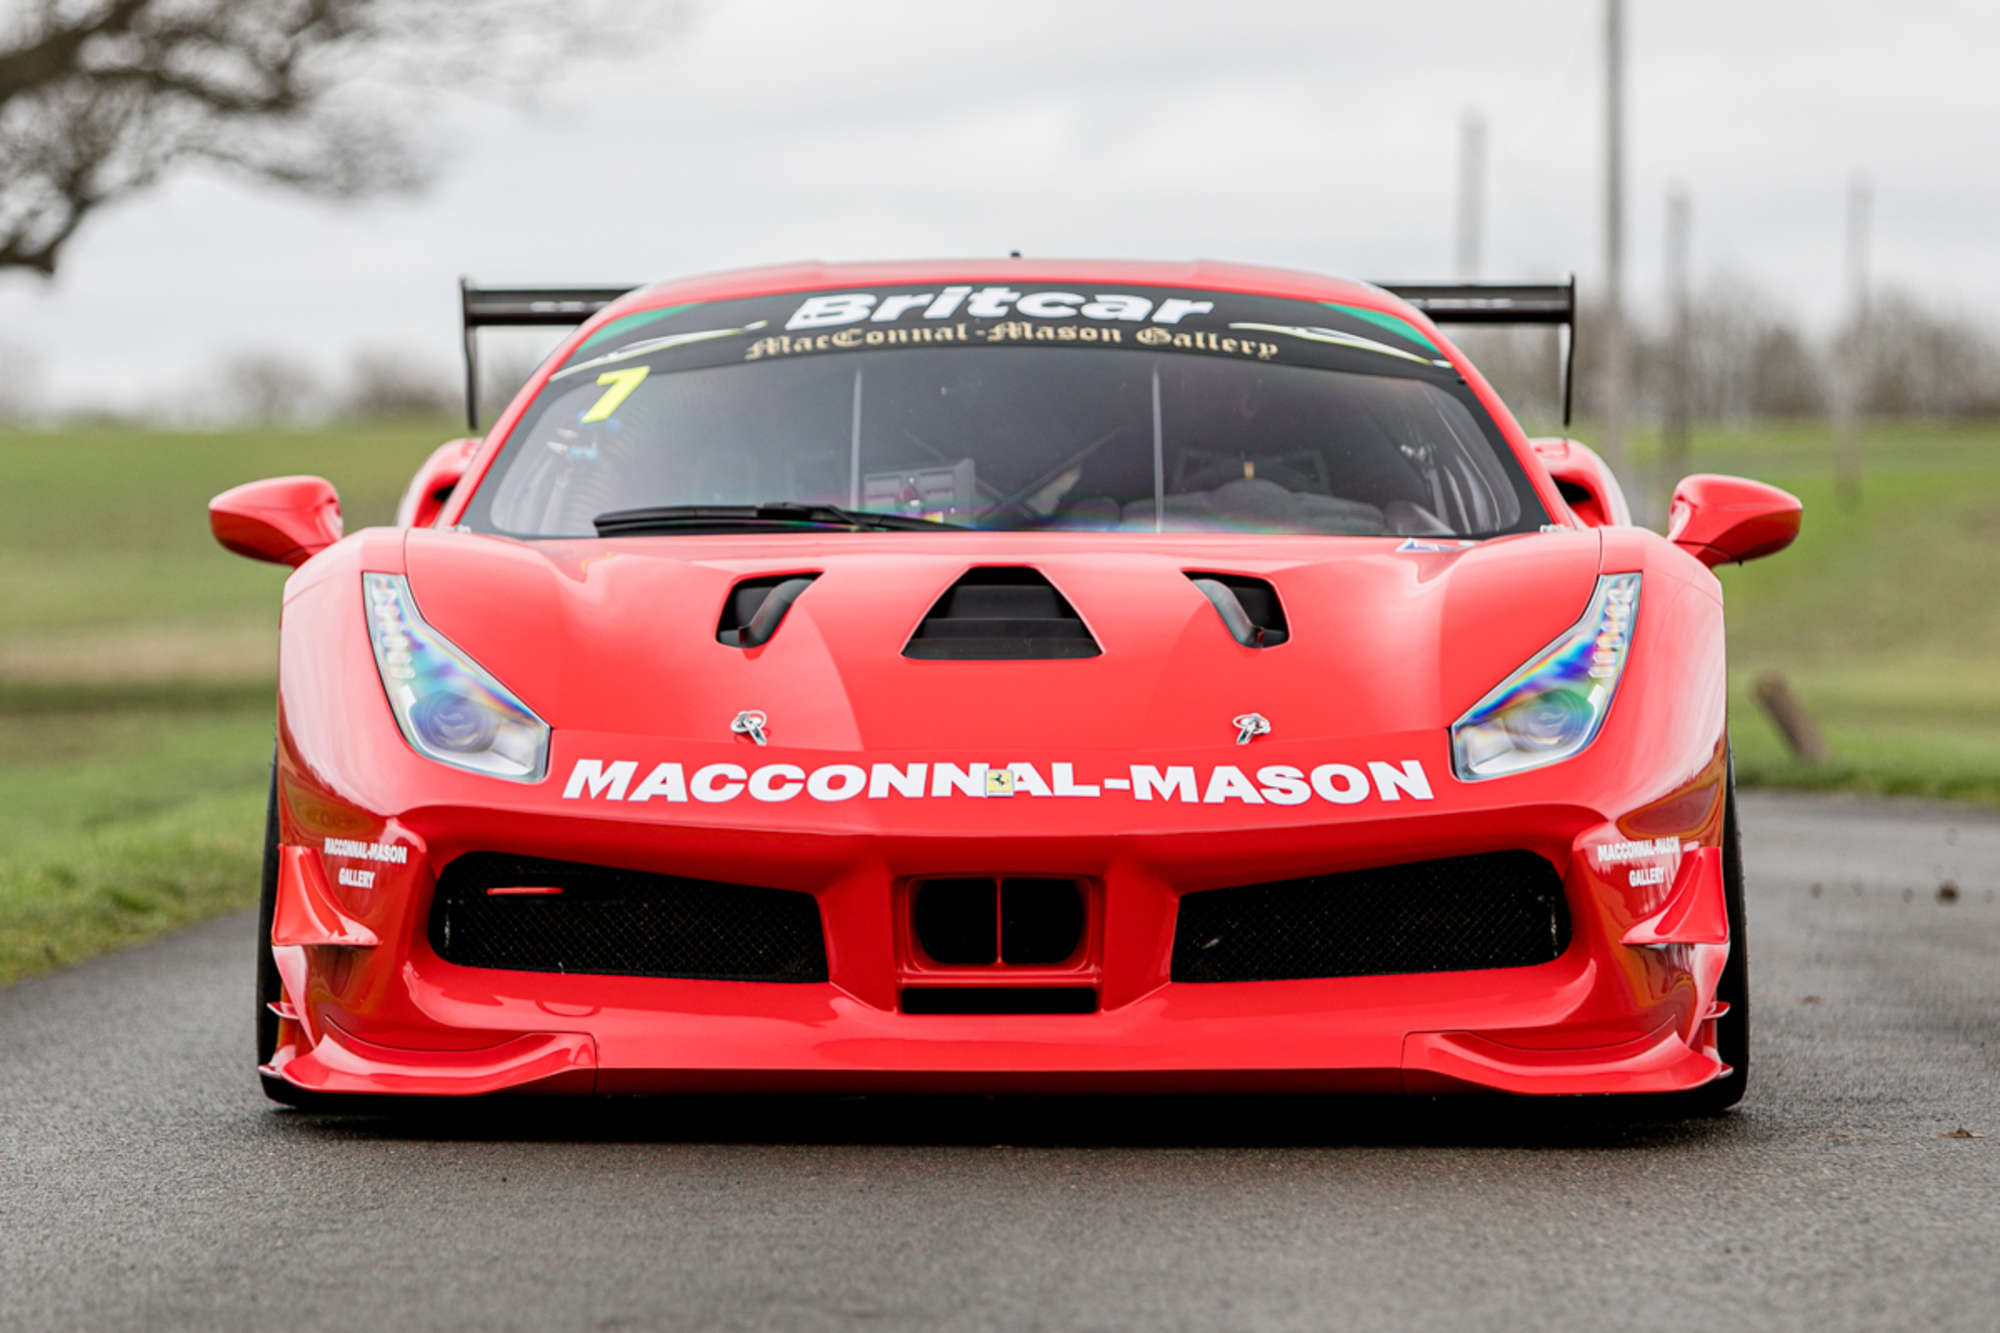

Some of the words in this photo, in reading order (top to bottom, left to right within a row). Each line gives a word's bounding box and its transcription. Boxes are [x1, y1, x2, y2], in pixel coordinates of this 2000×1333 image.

[785, 286, 1215, 331] Britcar
[1135, 327, 1279, 361] Gallery
[581, 365, 651, 424] 7
[562, 759, 1435, 805] MACCONNAL-MASON
